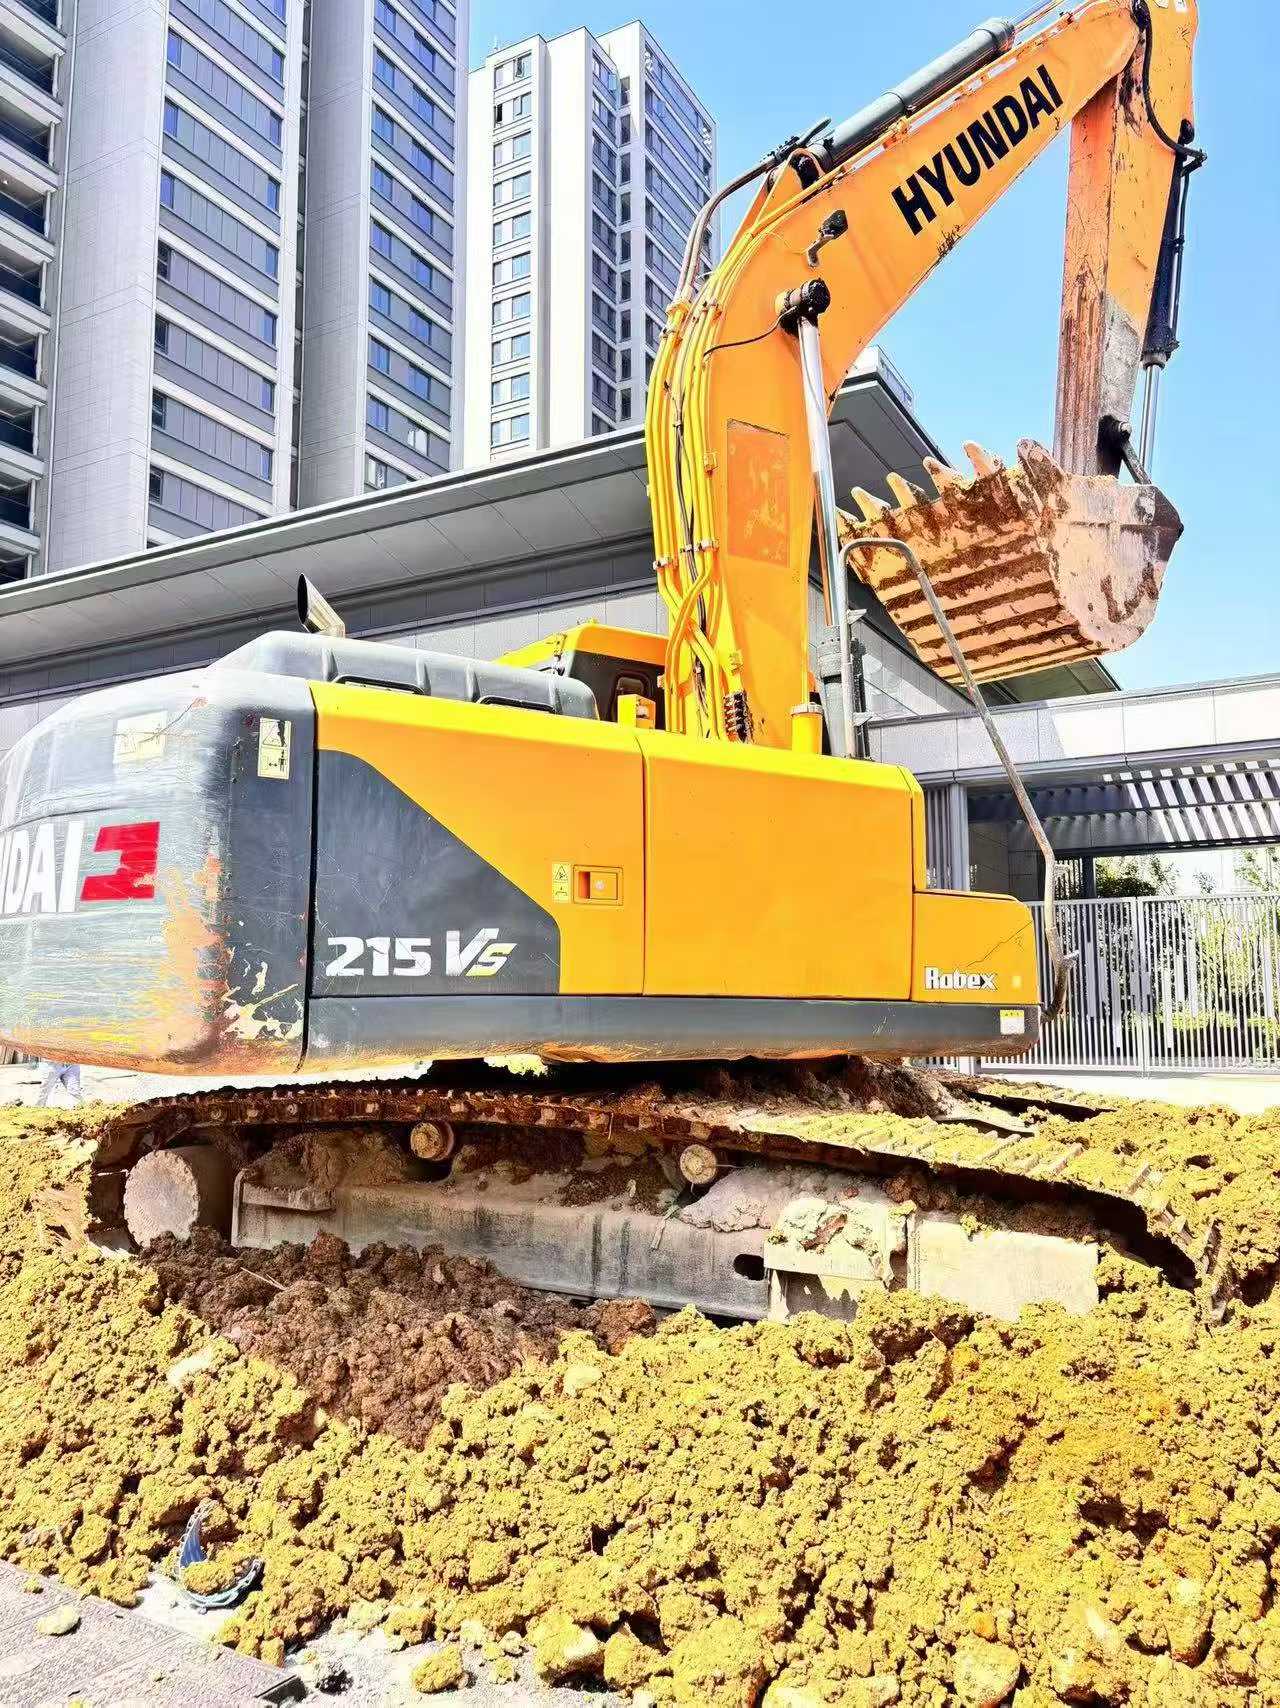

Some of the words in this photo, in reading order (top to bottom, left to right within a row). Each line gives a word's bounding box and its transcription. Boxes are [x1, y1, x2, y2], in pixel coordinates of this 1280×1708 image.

[891, 64, 1064, 236] HYUNDAI
[325, 936, 432, 977] 215
[925, 966, 998, 991] Robex
